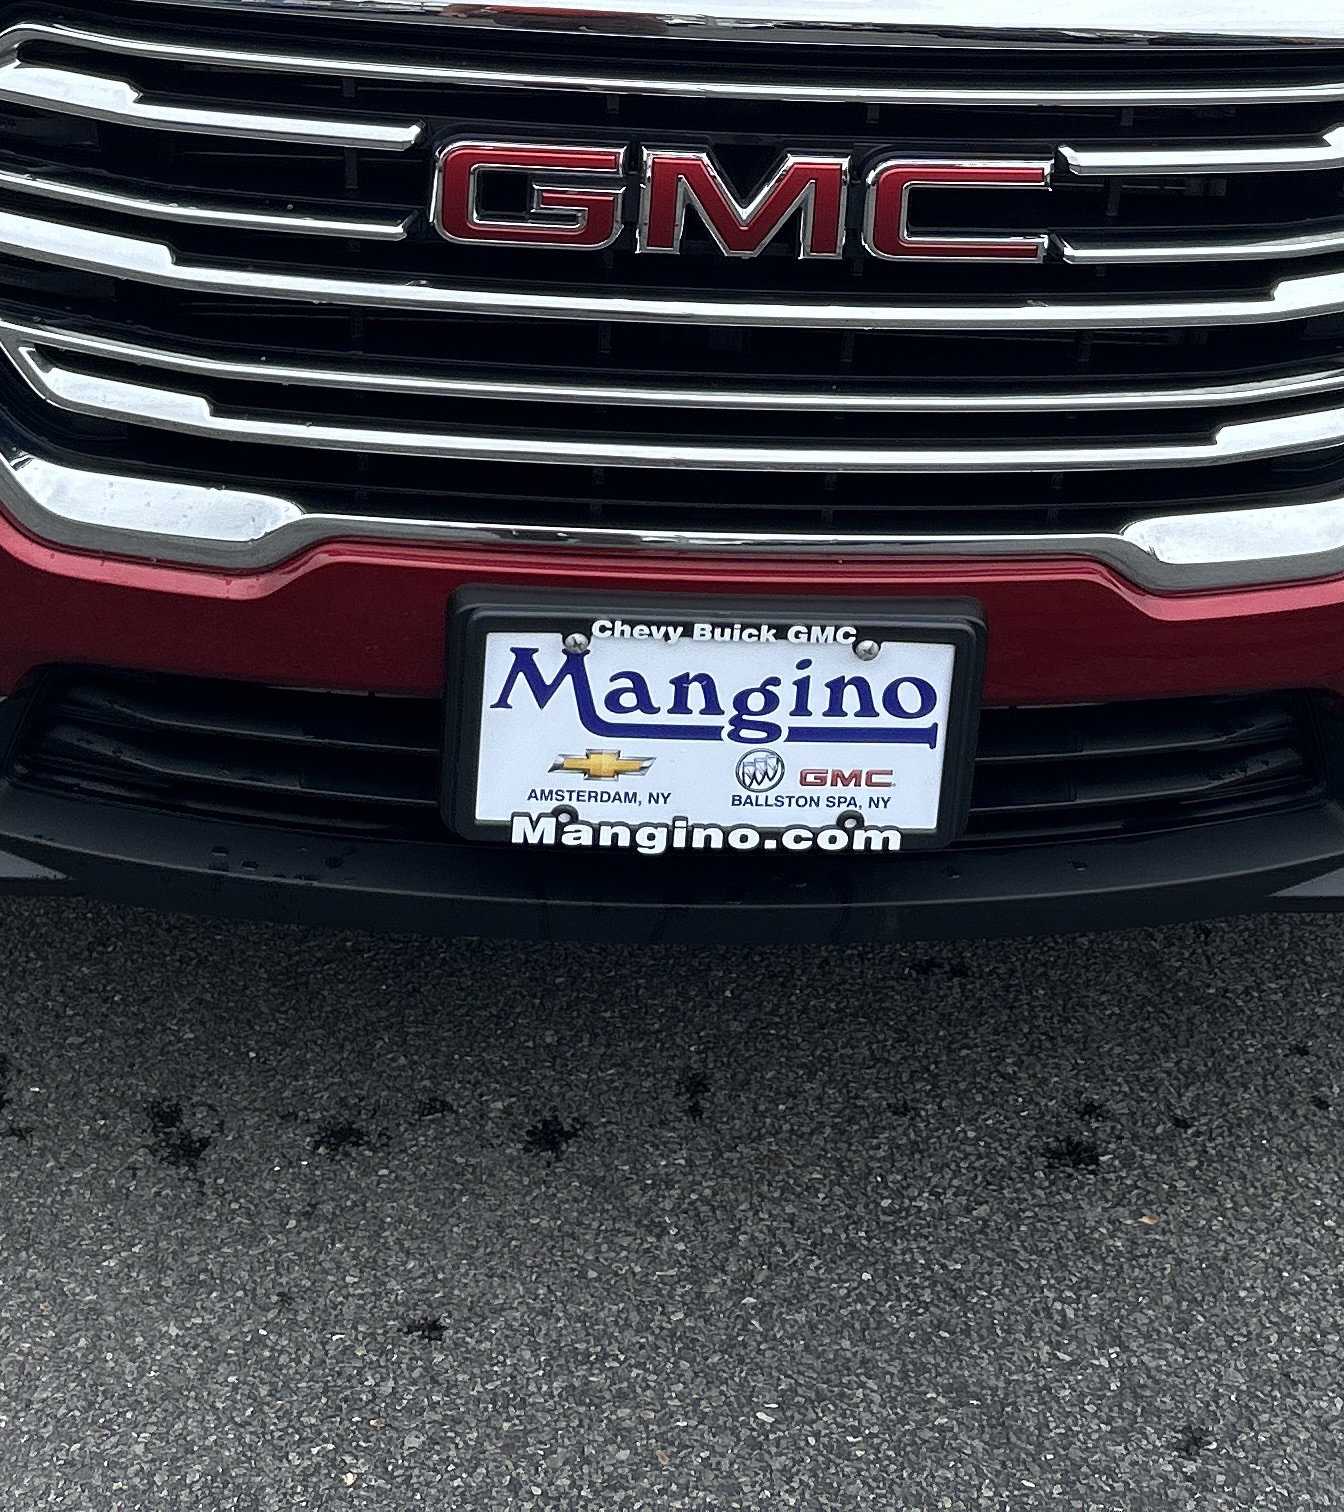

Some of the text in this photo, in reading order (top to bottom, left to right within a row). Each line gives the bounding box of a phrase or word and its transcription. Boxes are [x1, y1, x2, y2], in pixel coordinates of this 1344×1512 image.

[430, 140, 1053, 264] GMC
[591, 619, 858, 645] Chevy Buick GMC
[490, 646, 939, 749] Mangino
[799, 768, 894, 788] GMC
[526, 788, 672, 807] AMSTERDAM, NY
[731, 794, 892, 811] BALLSTON SPA, NY
[511, 815, 902, 856] Mangino.com
